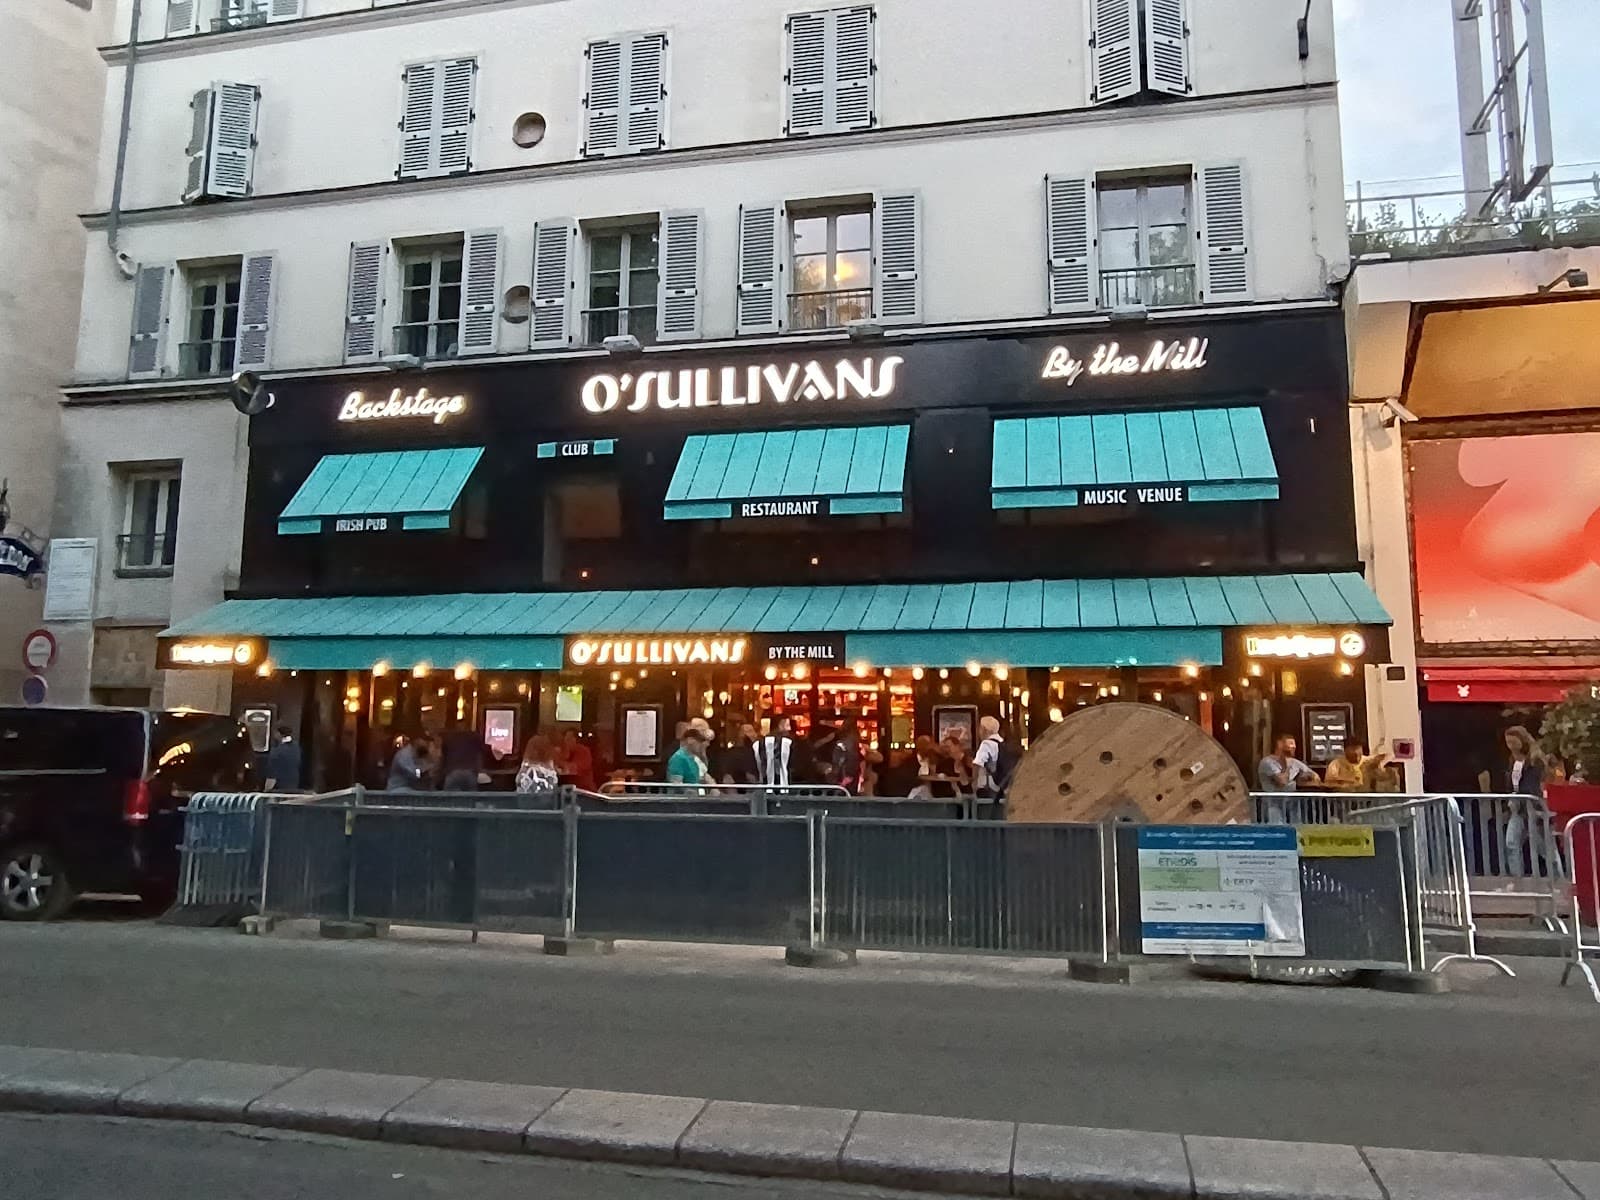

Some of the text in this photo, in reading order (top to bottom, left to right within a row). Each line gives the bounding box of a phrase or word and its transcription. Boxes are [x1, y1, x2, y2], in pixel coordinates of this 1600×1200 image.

[1041, 337, 1209, 386] By the Mill
[581, 355, 904, 413] O'SULLIVANS
[337, 387, 465, 425] Backstage
[562, 443, 589, 457] CLUB
[1084, 486, 1183, 505] MUSIC VENUE
[741, 500, 819, 518] RESTAURANT
[335, 518, 388, 532] IRISH PUB
[570, 638, 748, 665] O'SULLIVANS
[768, 645, 834, 659] BY THE MILL
